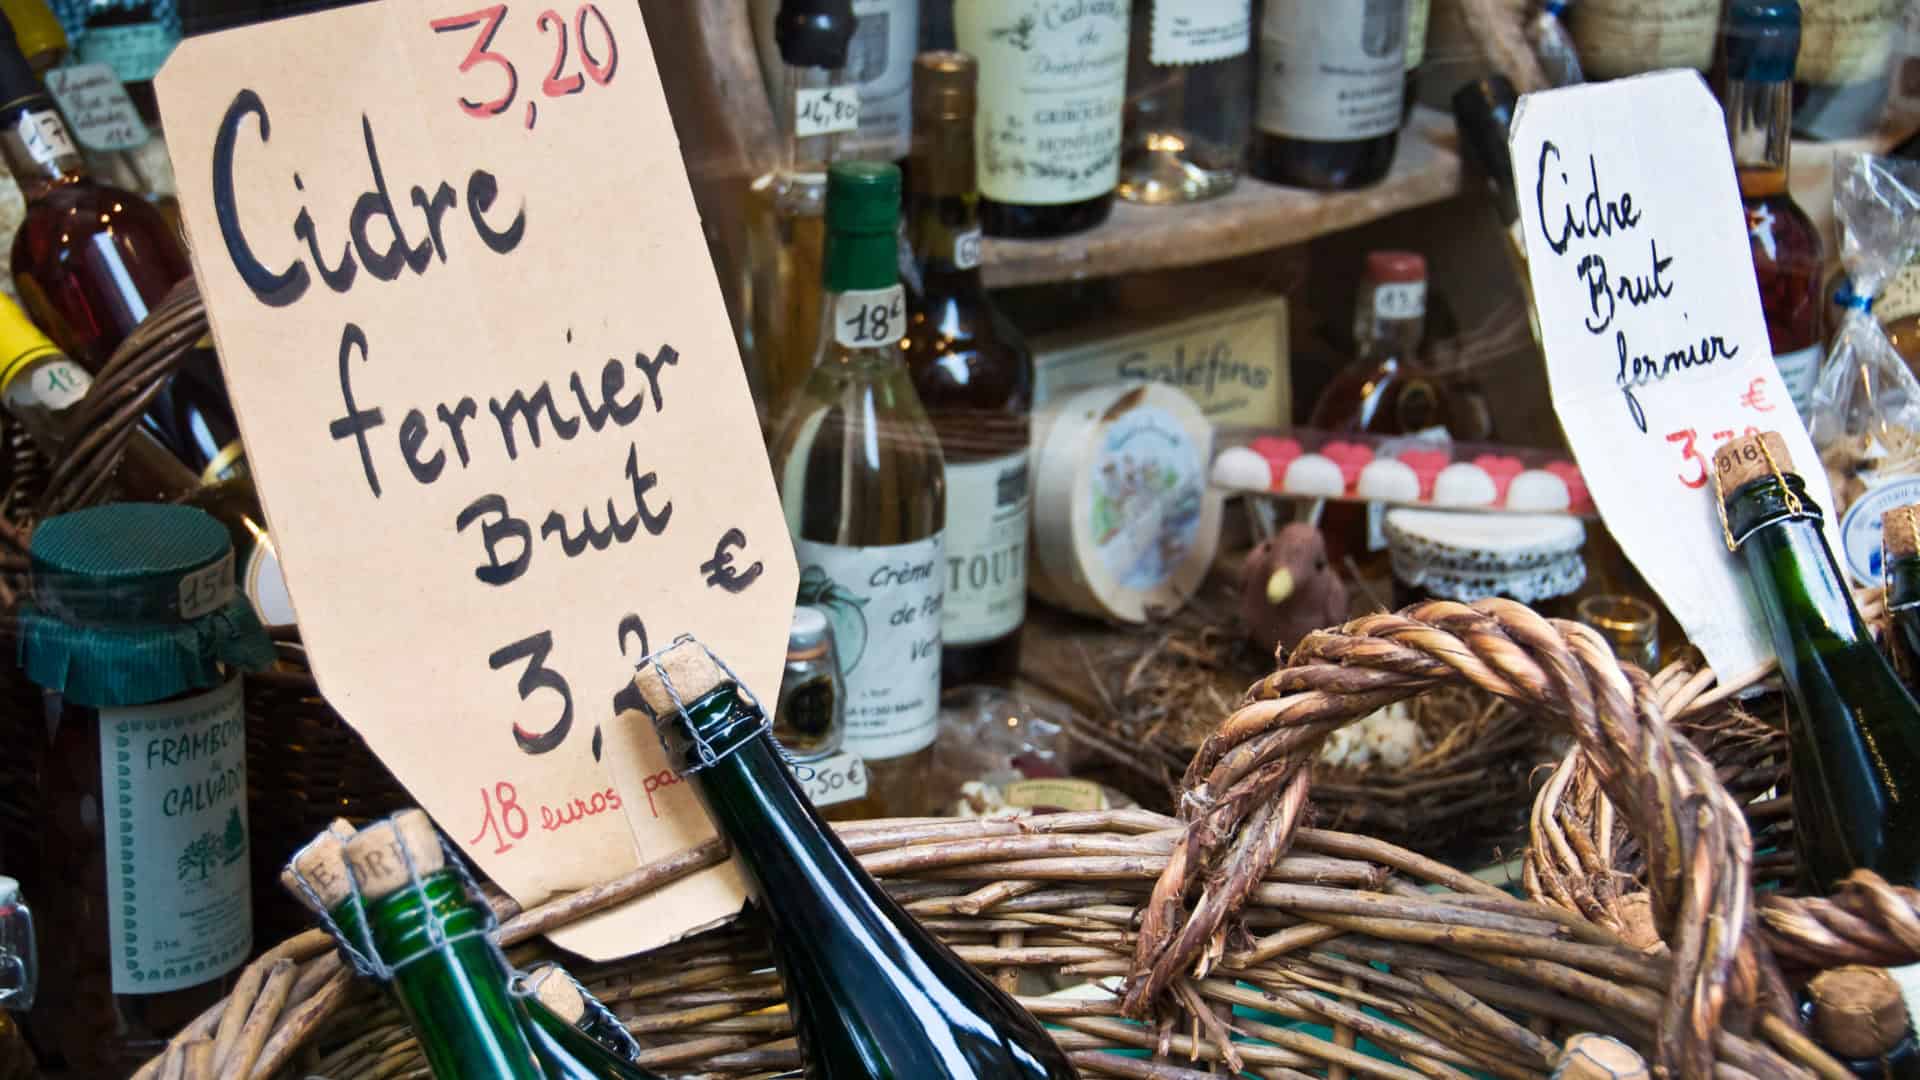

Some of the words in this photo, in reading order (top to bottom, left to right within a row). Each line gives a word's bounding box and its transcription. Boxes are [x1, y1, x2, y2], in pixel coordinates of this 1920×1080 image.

[430, 3, 618, 130] 3,20
[211, 88, 527, 308] Cidre
[1537, 140, 1641, 255] Cidre
[1577, 239, 1674, 334] Brut
[330, 322, 679, 499] fermier
[1616, 312, 1740, 434] fermier
[1740, 377, 1777, 413] €
[456, 441, 672, 587] Brut
[700, 527, 764, 593] €
[890, 603, 915, 626] de
[469, 781, 529, 855] 18
[541, 786, 623, 831] euros
[643, 768, 686, 819] pa
